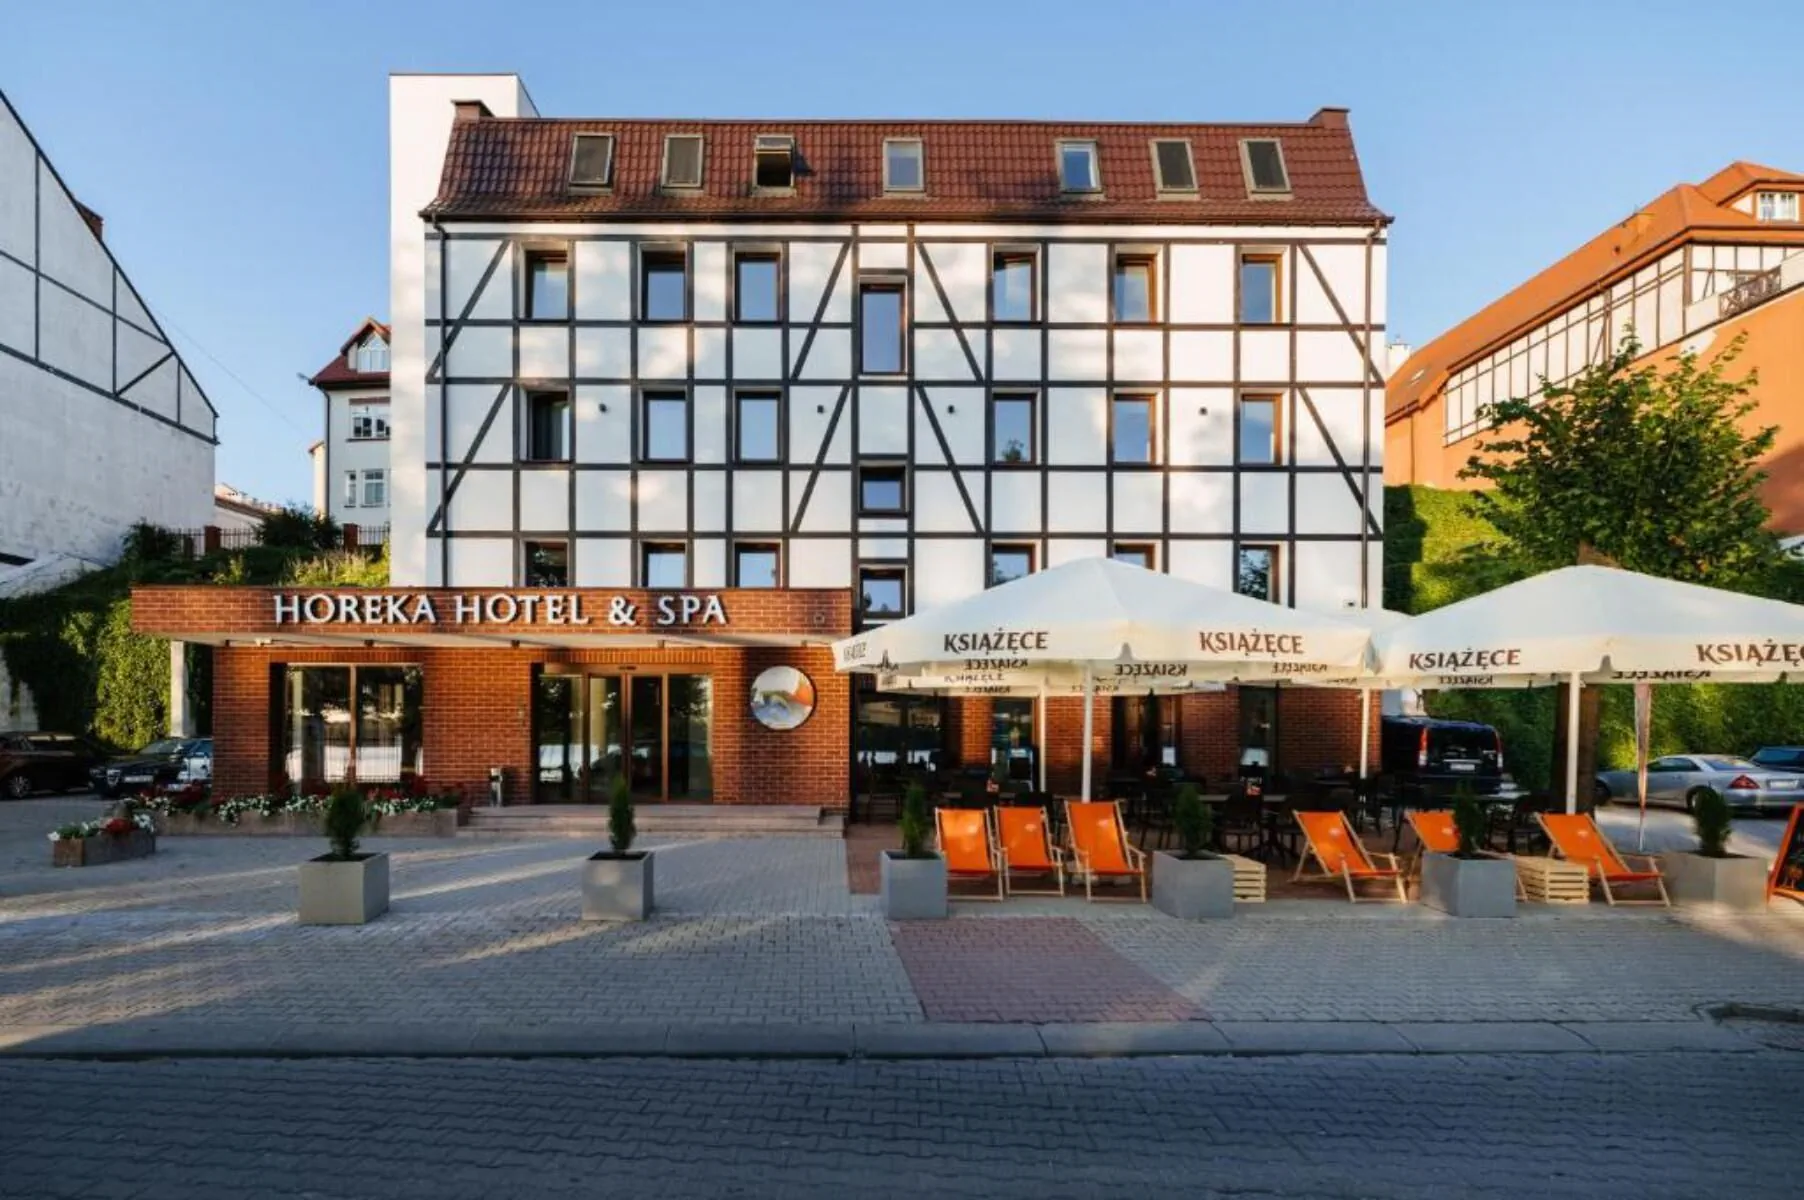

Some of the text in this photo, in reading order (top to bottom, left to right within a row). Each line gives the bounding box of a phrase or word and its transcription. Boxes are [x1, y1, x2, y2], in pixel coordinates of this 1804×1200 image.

[274, 593, 727, 626] HOREKA HOTEL & SPA
[943, 628, 1048, 655] KSIĄŻĘCE
[1199, 628, 1304, 656] KSIĄŻĘCE
[1696, 638, 1804, 666] KSIĄŻĘ
[1409, 646, 1521, 671] KSIĄŻĘCE
